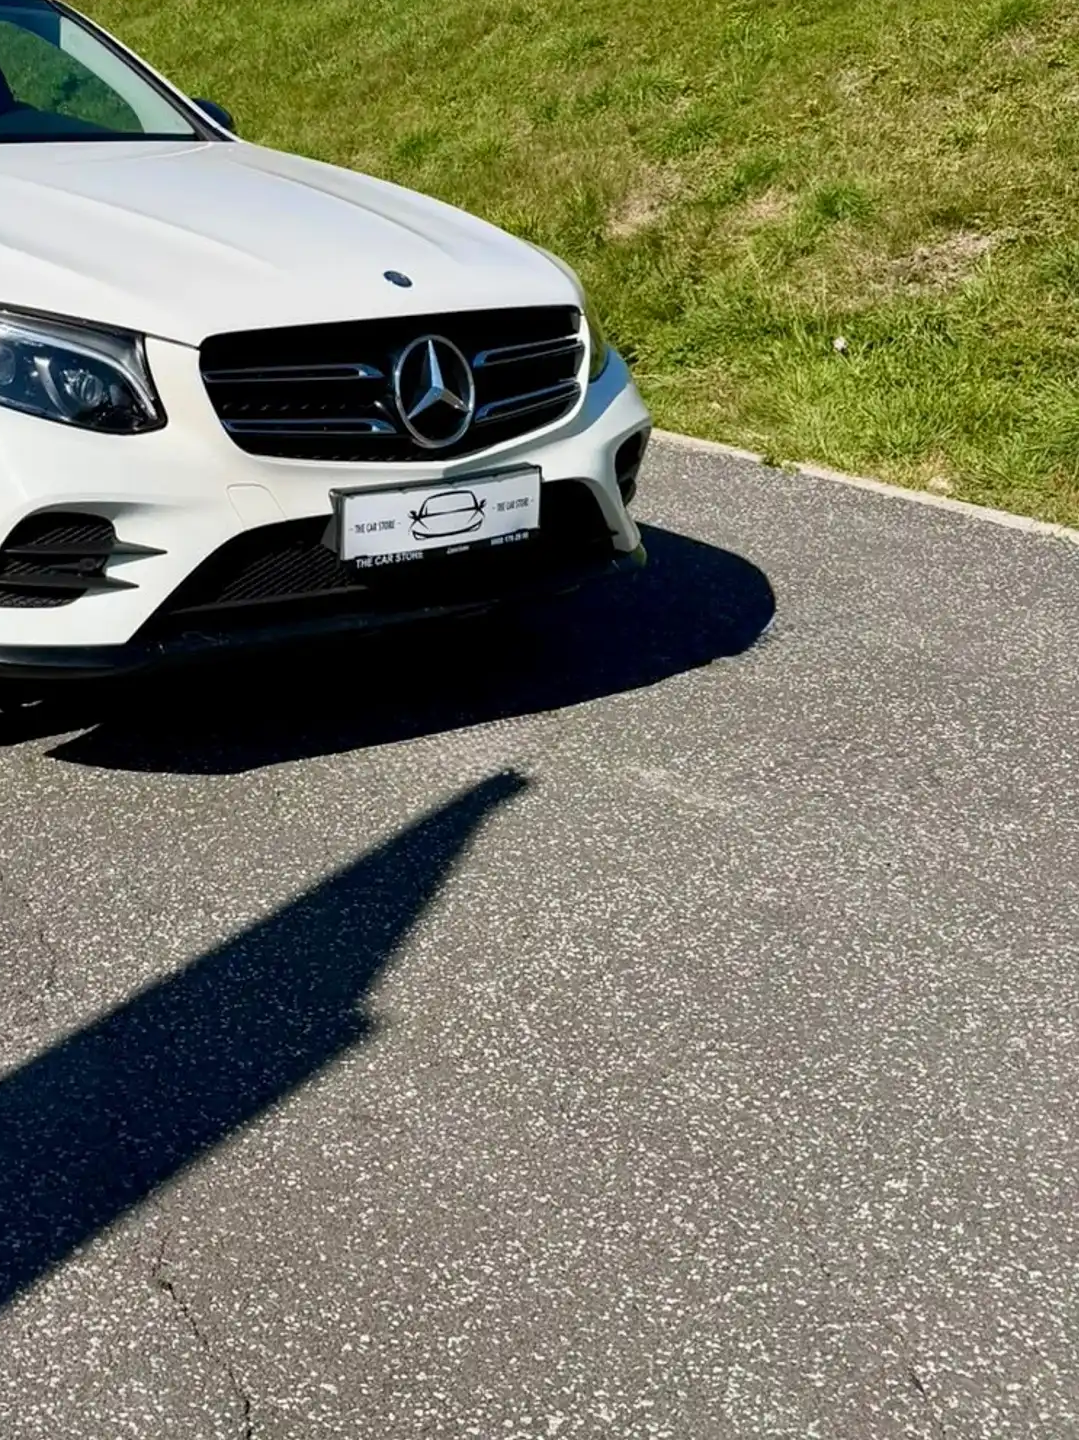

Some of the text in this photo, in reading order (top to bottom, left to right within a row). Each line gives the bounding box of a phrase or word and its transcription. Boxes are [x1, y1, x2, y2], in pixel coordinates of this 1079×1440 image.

[366, 522, 377, 533] CAR
[356, 550, 424, 569] THE CAR STORE
